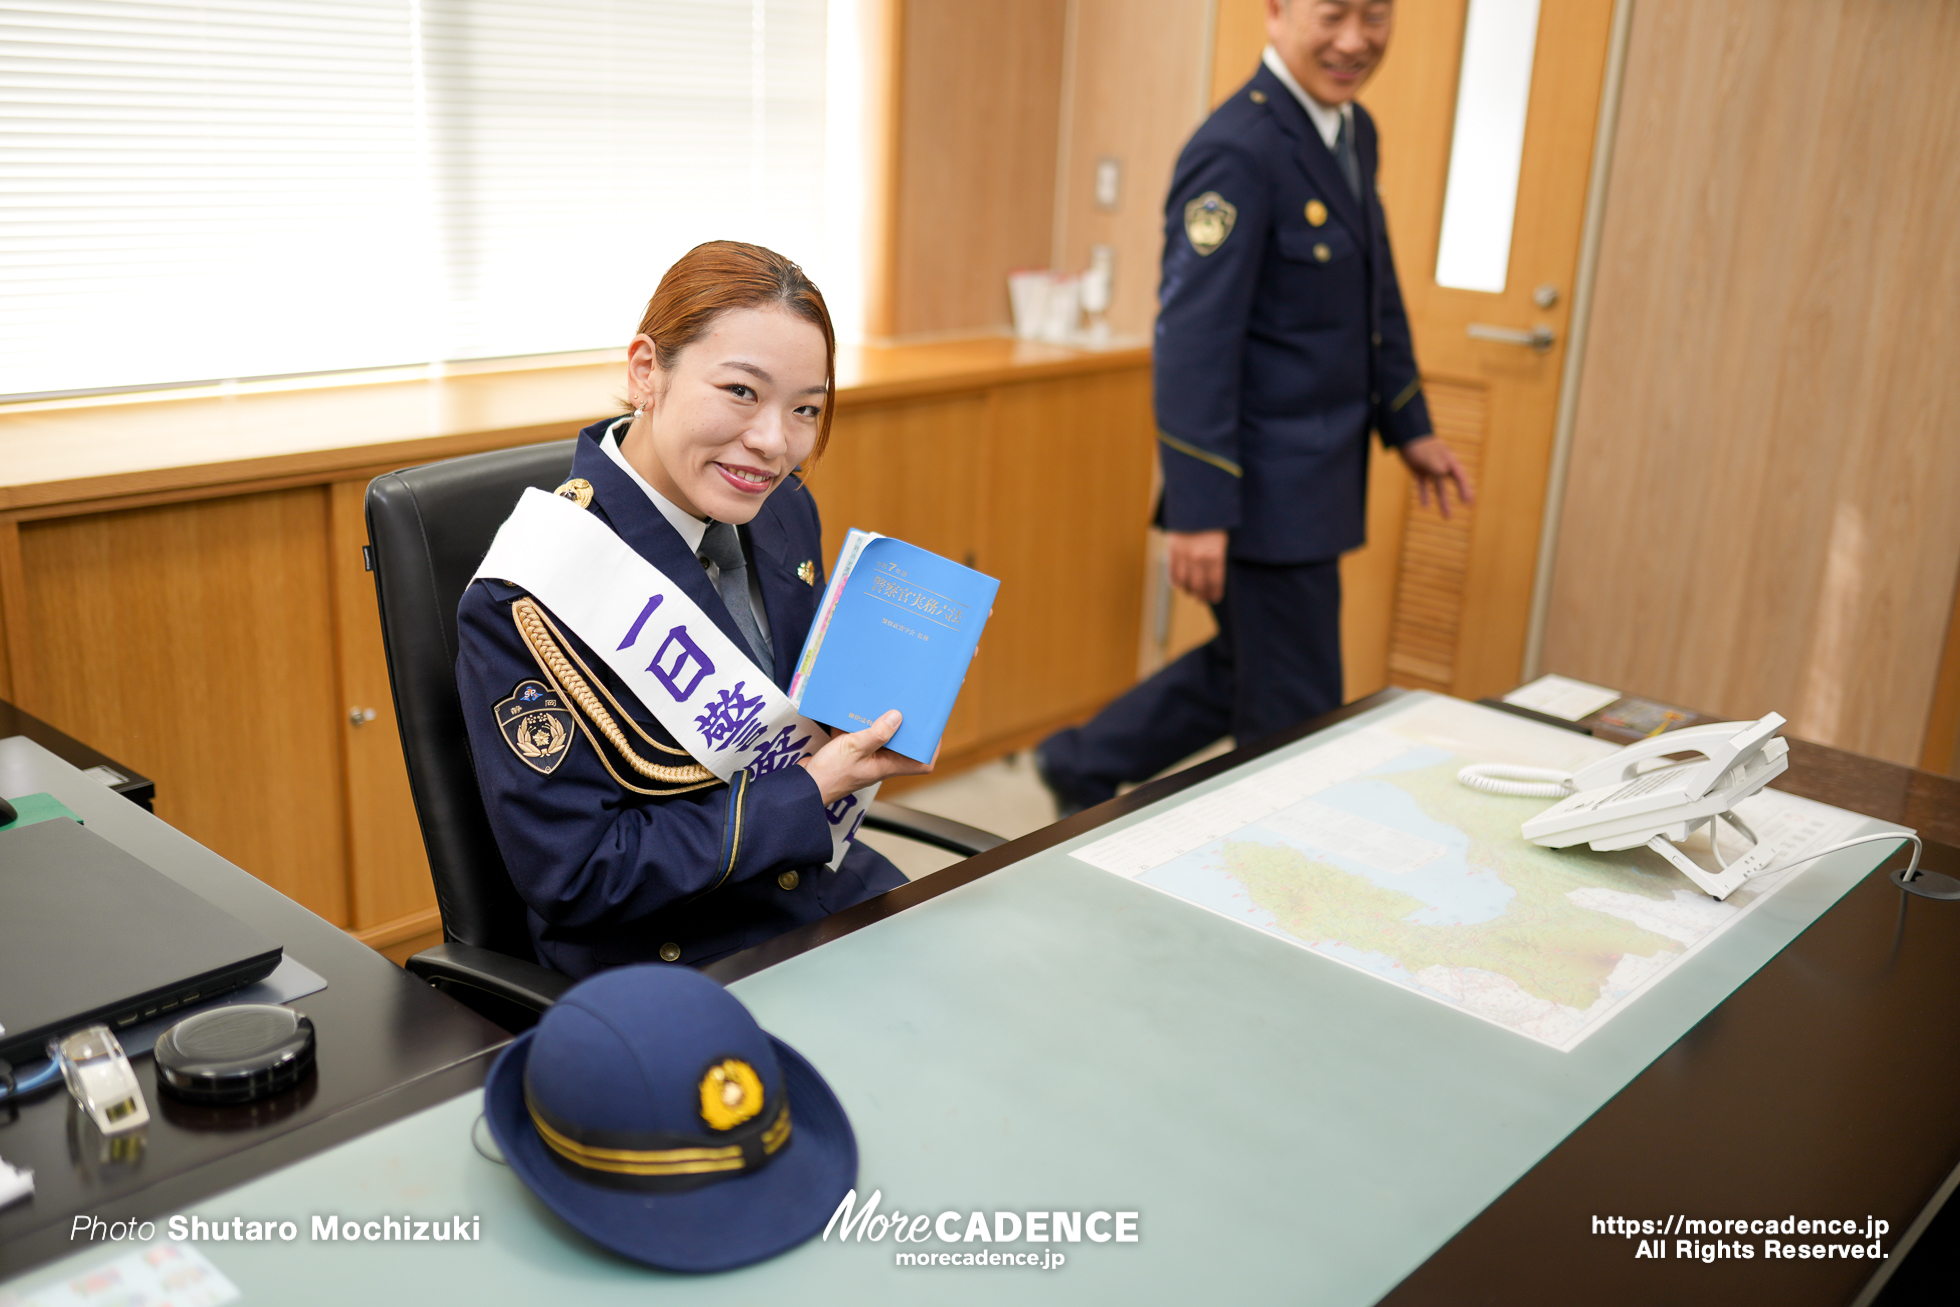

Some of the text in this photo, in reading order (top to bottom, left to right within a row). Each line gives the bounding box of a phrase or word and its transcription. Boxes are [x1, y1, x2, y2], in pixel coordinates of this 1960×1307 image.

[871, 575, 964, 625] 警察官実務六法
[615, 593, 866, 843] 一日警察
